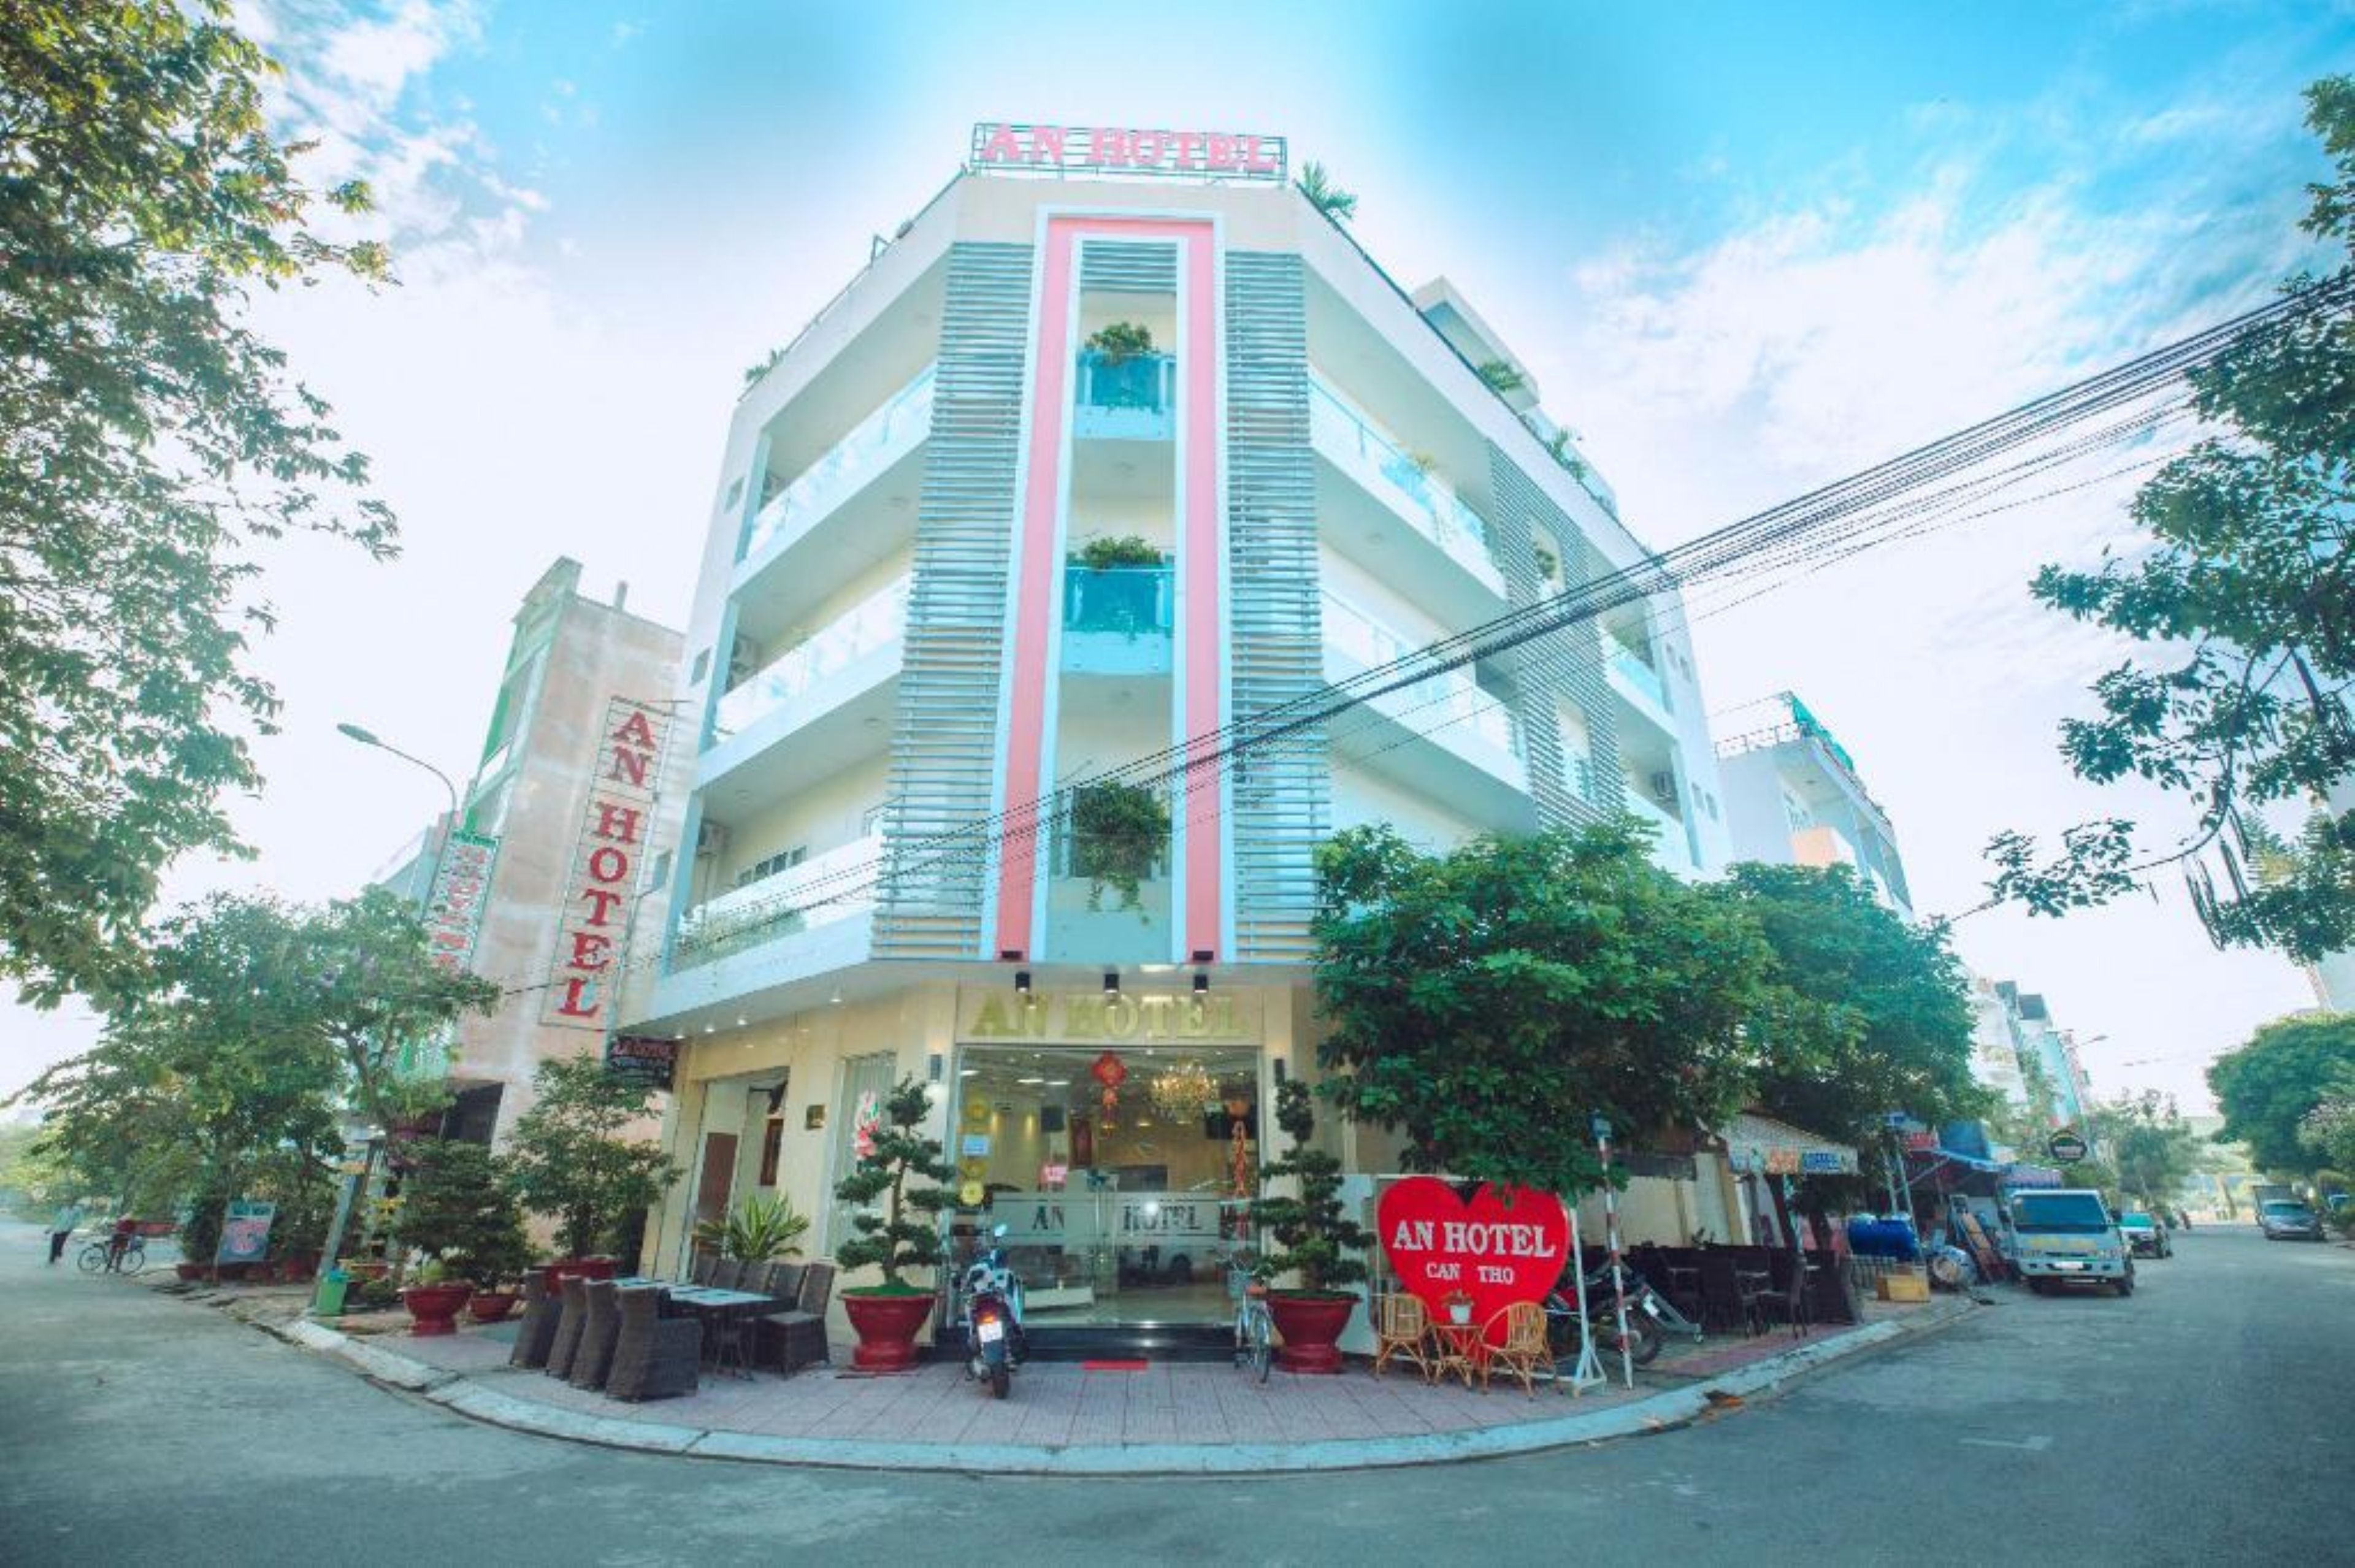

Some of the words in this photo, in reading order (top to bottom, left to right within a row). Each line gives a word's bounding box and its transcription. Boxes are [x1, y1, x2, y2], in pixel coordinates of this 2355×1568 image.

[982, 122, 1068, 164] AN
[1086, 127, 1277, 170] HOTEL
[608, 710, 655, 789] AN
[558, 801, 641, 1017] HOTEL
[969, 990, 1051, 1037] AN
[1061, 992, 1250, 1039] HOTEL
[1032, 1205, 1065, 1230] AN
[1393, 1220, 1435, 1251] AN
[1442, 1222, 1556, 1258] HOTEL
[1425, 1262, 1461, 1281] CAN
[1477, 1264, 1514, 1285] THO
